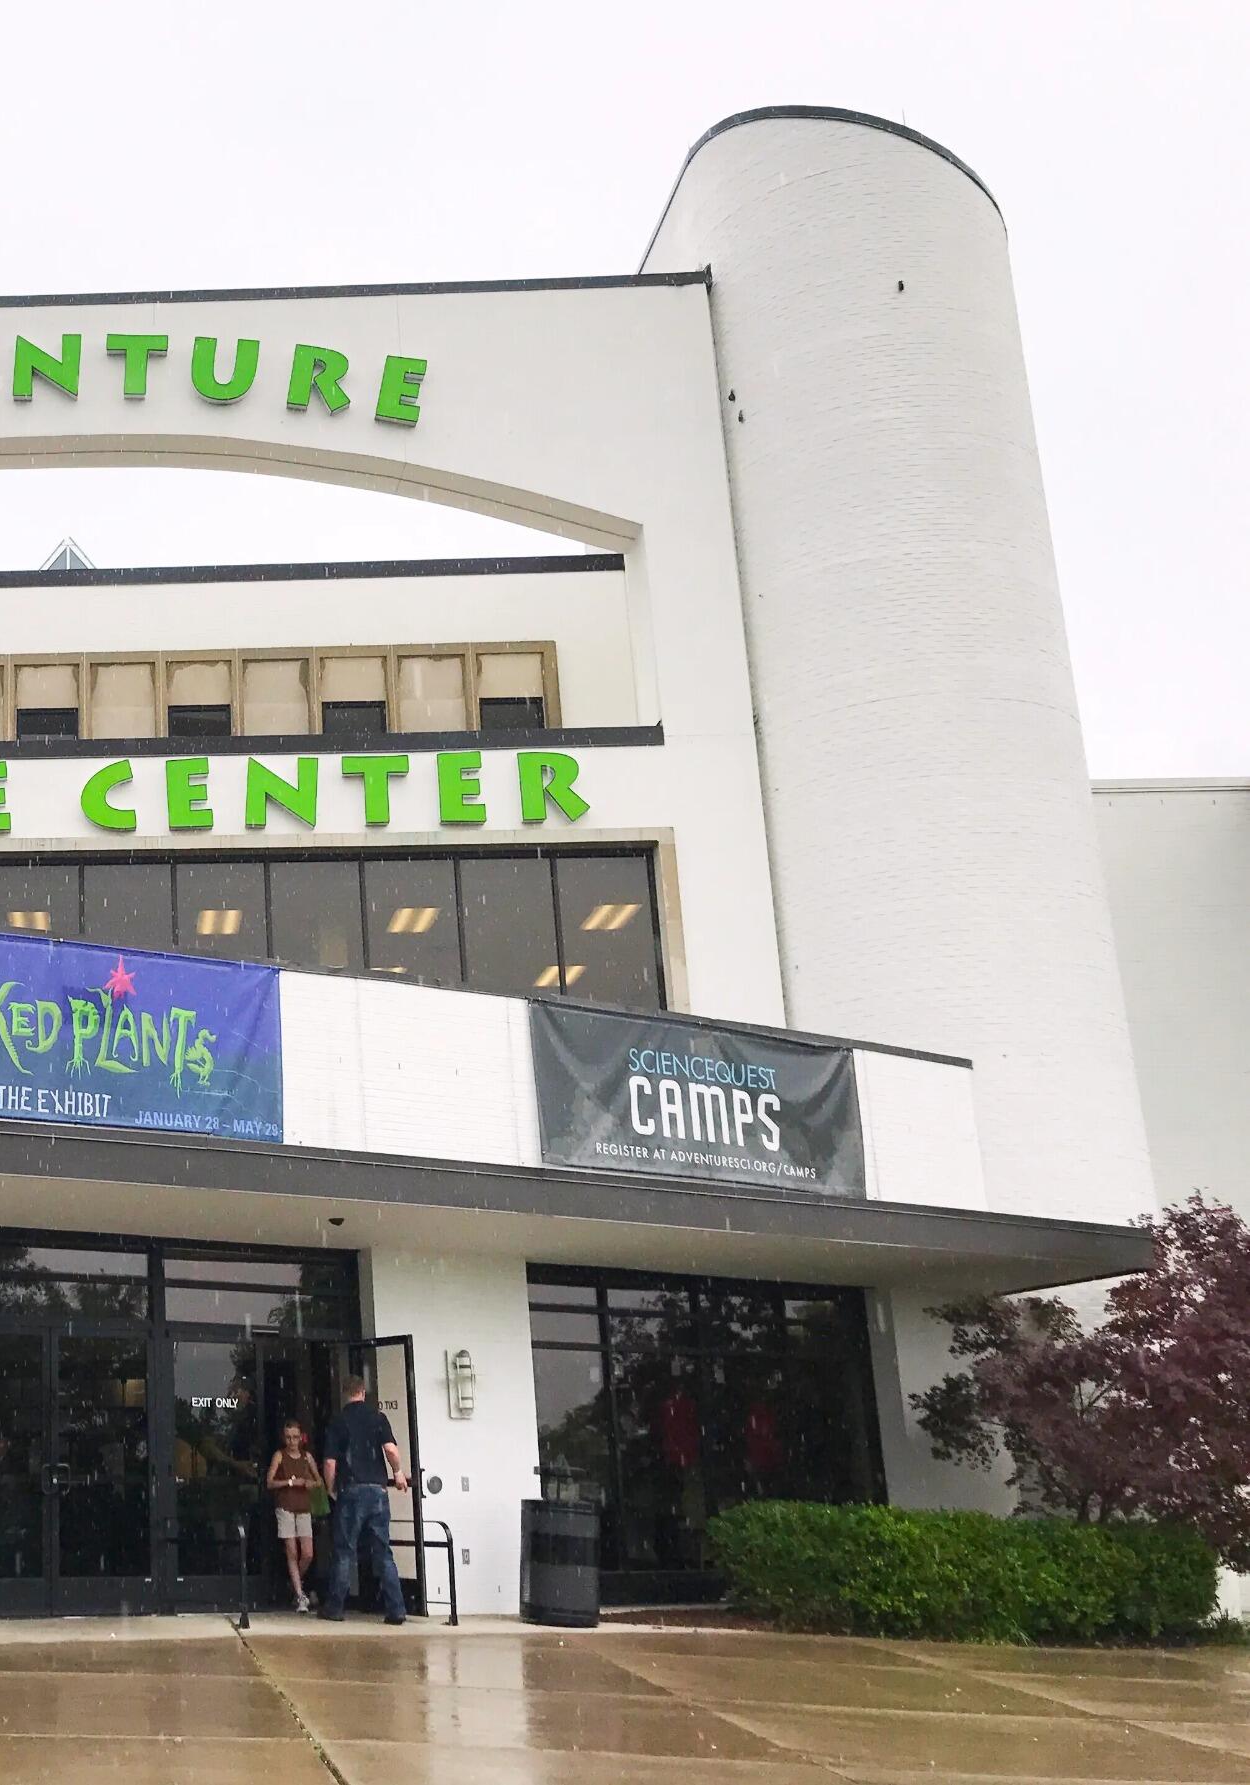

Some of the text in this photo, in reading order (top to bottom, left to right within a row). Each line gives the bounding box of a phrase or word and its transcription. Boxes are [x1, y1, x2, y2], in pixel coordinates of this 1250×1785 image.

[80, 750, 591, 831] CENTER
[65, 984, 217, 1099] PLANTS
[627, 1047, 776, 1091] SCIENCEQUEST
[37, 1088, 112, 1119] EXHIBIT
[134, 1110, 202, 1129] JANUARY
[205, 1116, 219, 1130] 28
[233, 1118, 262, 1137] MAY
[628, 1075, 781, 1152] CAMPS
[595, 1141, 816, 1179] REGISTER AT ADVENTURESCI.ORG/CAMPS
[191, 1396, 239, 1409] EXIT ONLY
